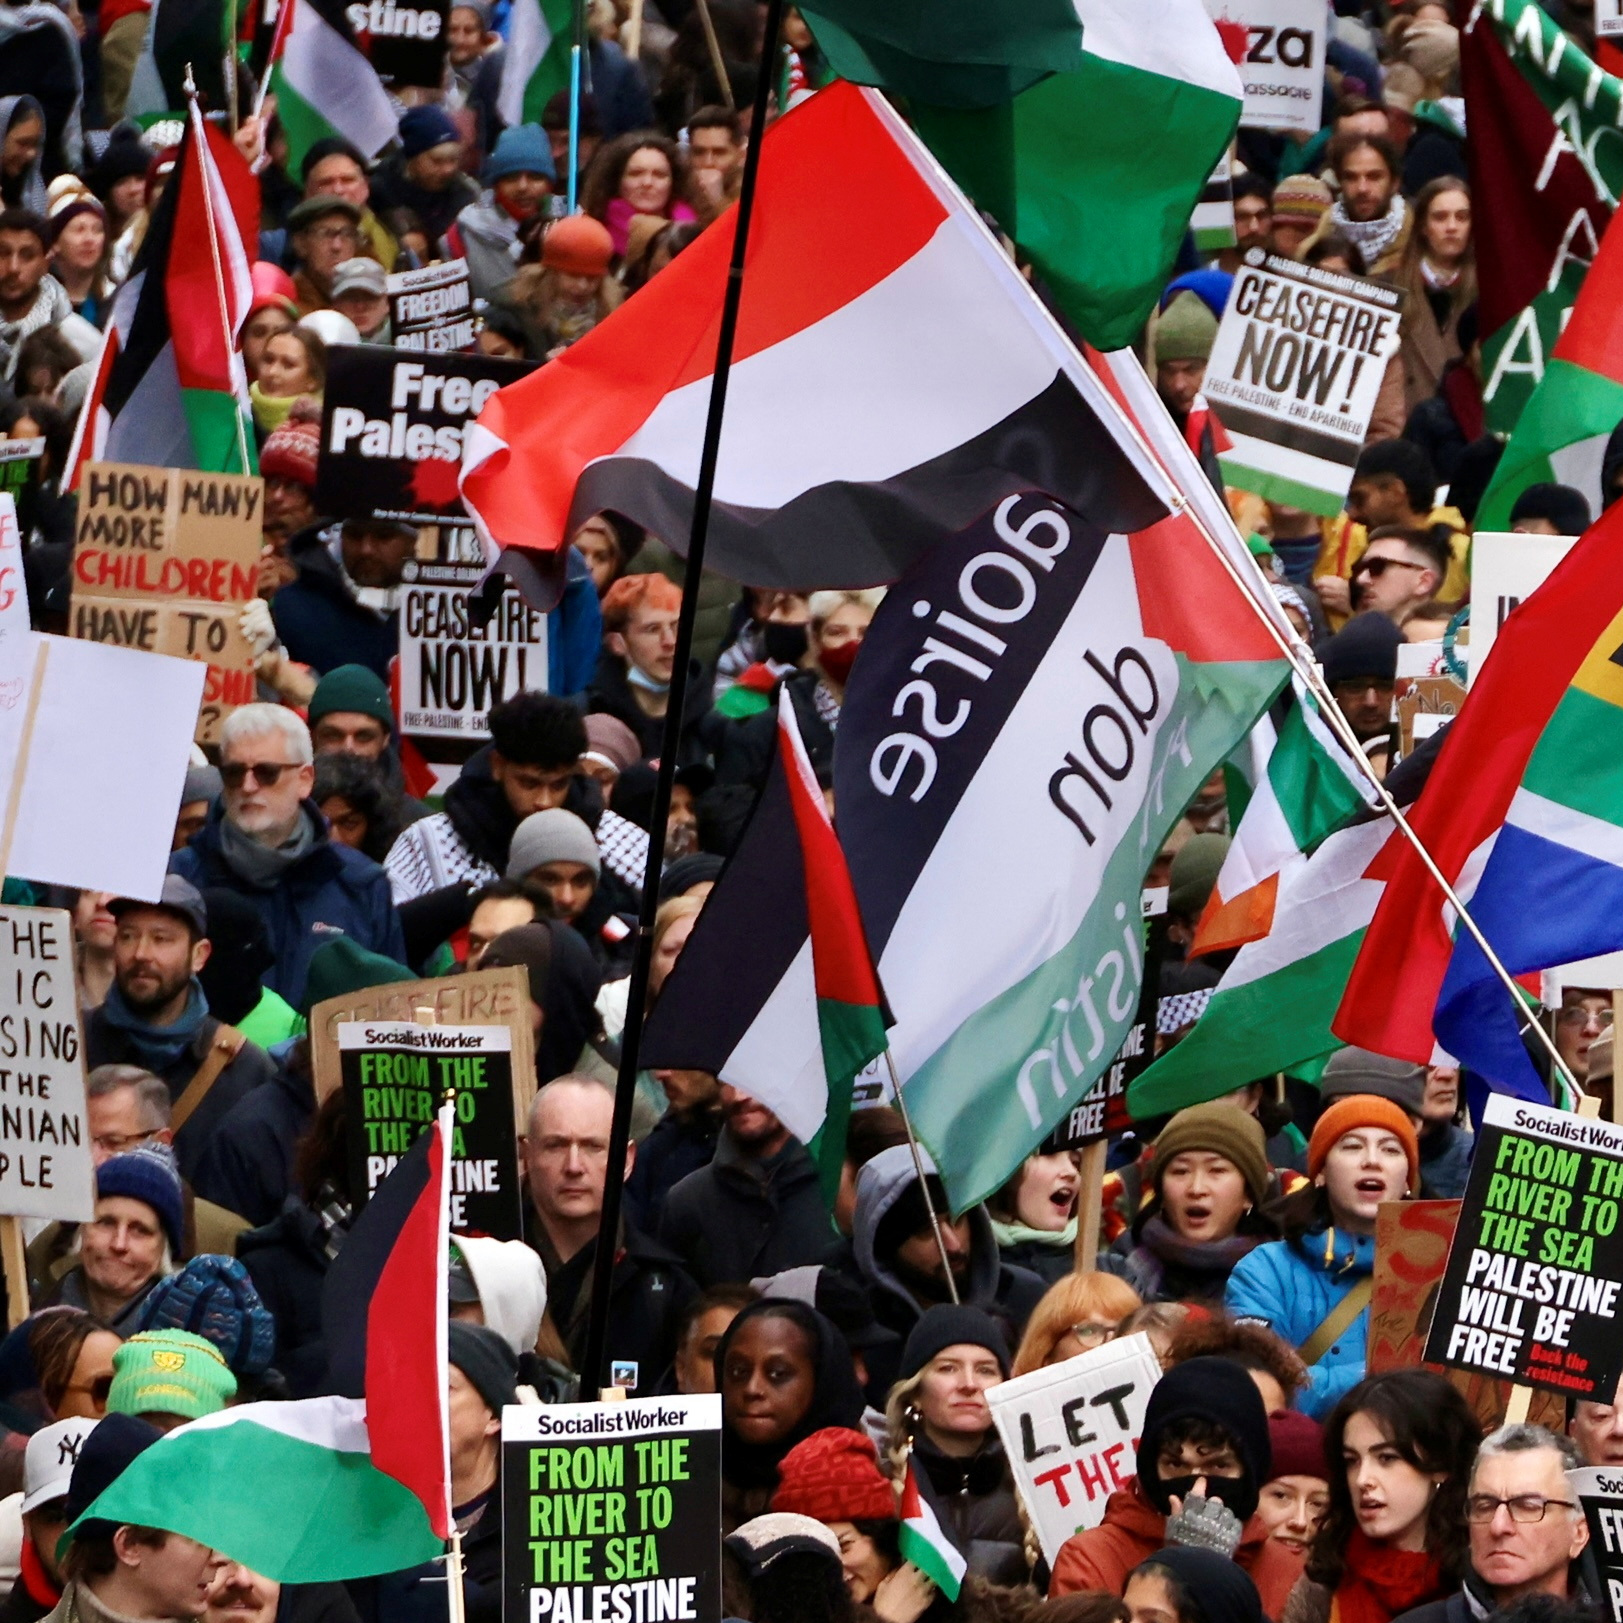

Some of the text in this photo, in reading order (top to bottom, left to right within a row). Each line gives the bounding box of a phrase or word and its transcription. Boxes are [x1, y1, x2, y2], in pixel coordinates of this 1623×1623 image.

[1236, 274, 1393, 357] CEASEFIRE
[392, 362, 501, 414] Free
[1233, 322, 1366, 413] NOW!
[89, 472, 260, 520] HOW MANY
[79, 514, 165, 550] MORE
[76, 550, 258, 600] CHILDREN
[76, 609, 227, 652] HAVE TO
[1019, 1383, 1135, 1461] LET
[529, 1438, 690, 1490] FROM THE
[530, 1486, 672, 1537] RIVER TO
[528, 1534, 659, 1583] THE SEA
